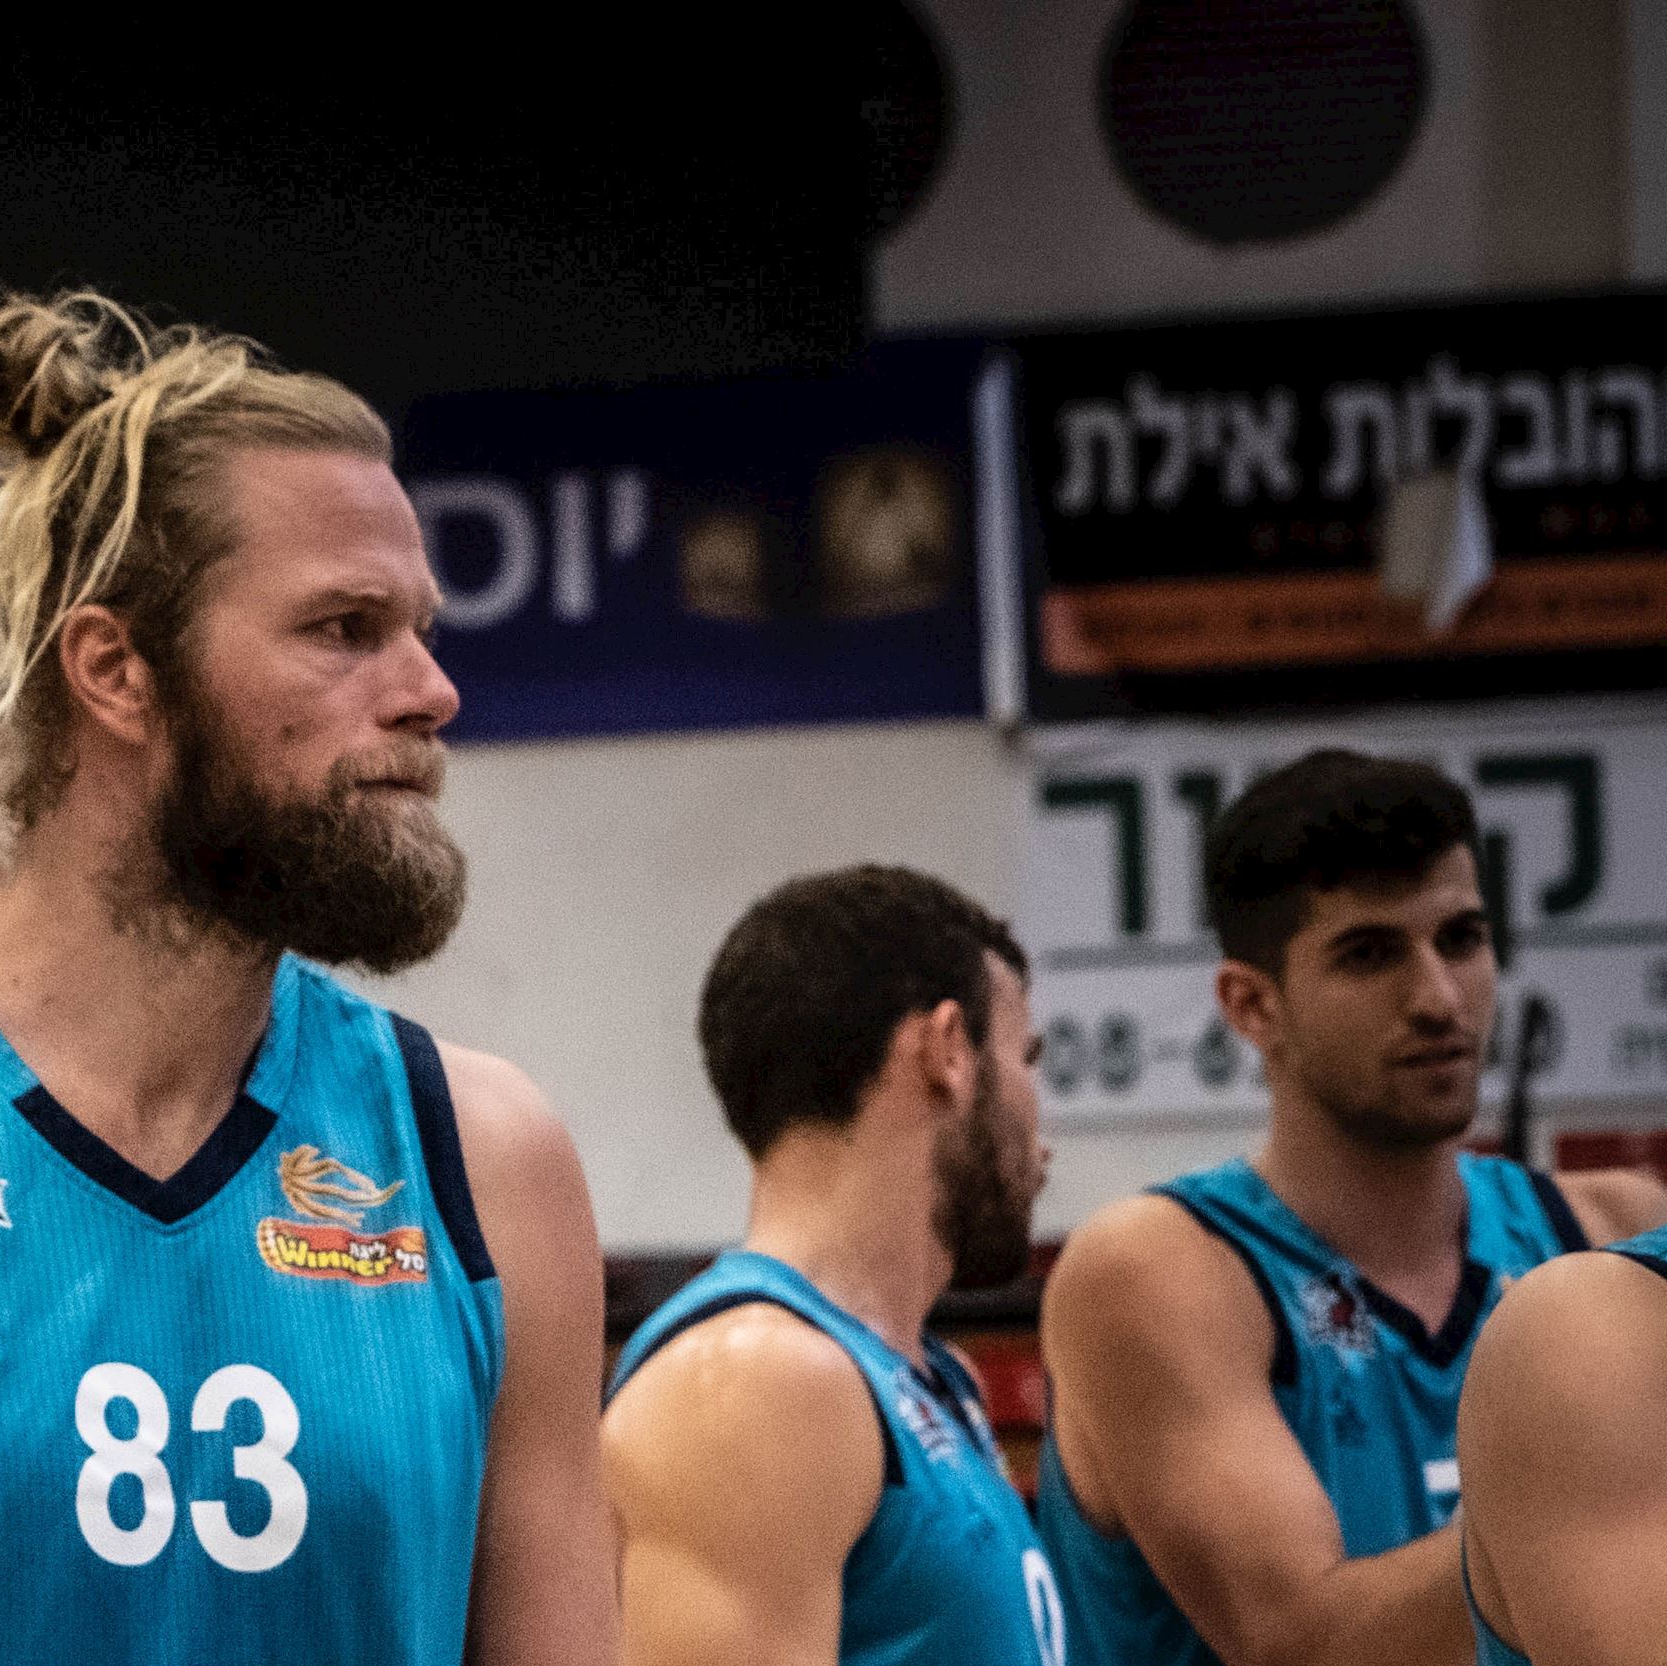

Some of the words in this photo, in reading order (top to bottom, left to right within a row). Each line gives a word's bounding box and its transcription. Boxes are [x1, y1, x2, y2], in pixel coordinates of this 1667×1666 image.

[427, 464, 652, 625] יוס
[275, 1234, 394, 1277] Winner
[74, 1361, 309, 1573] 83
